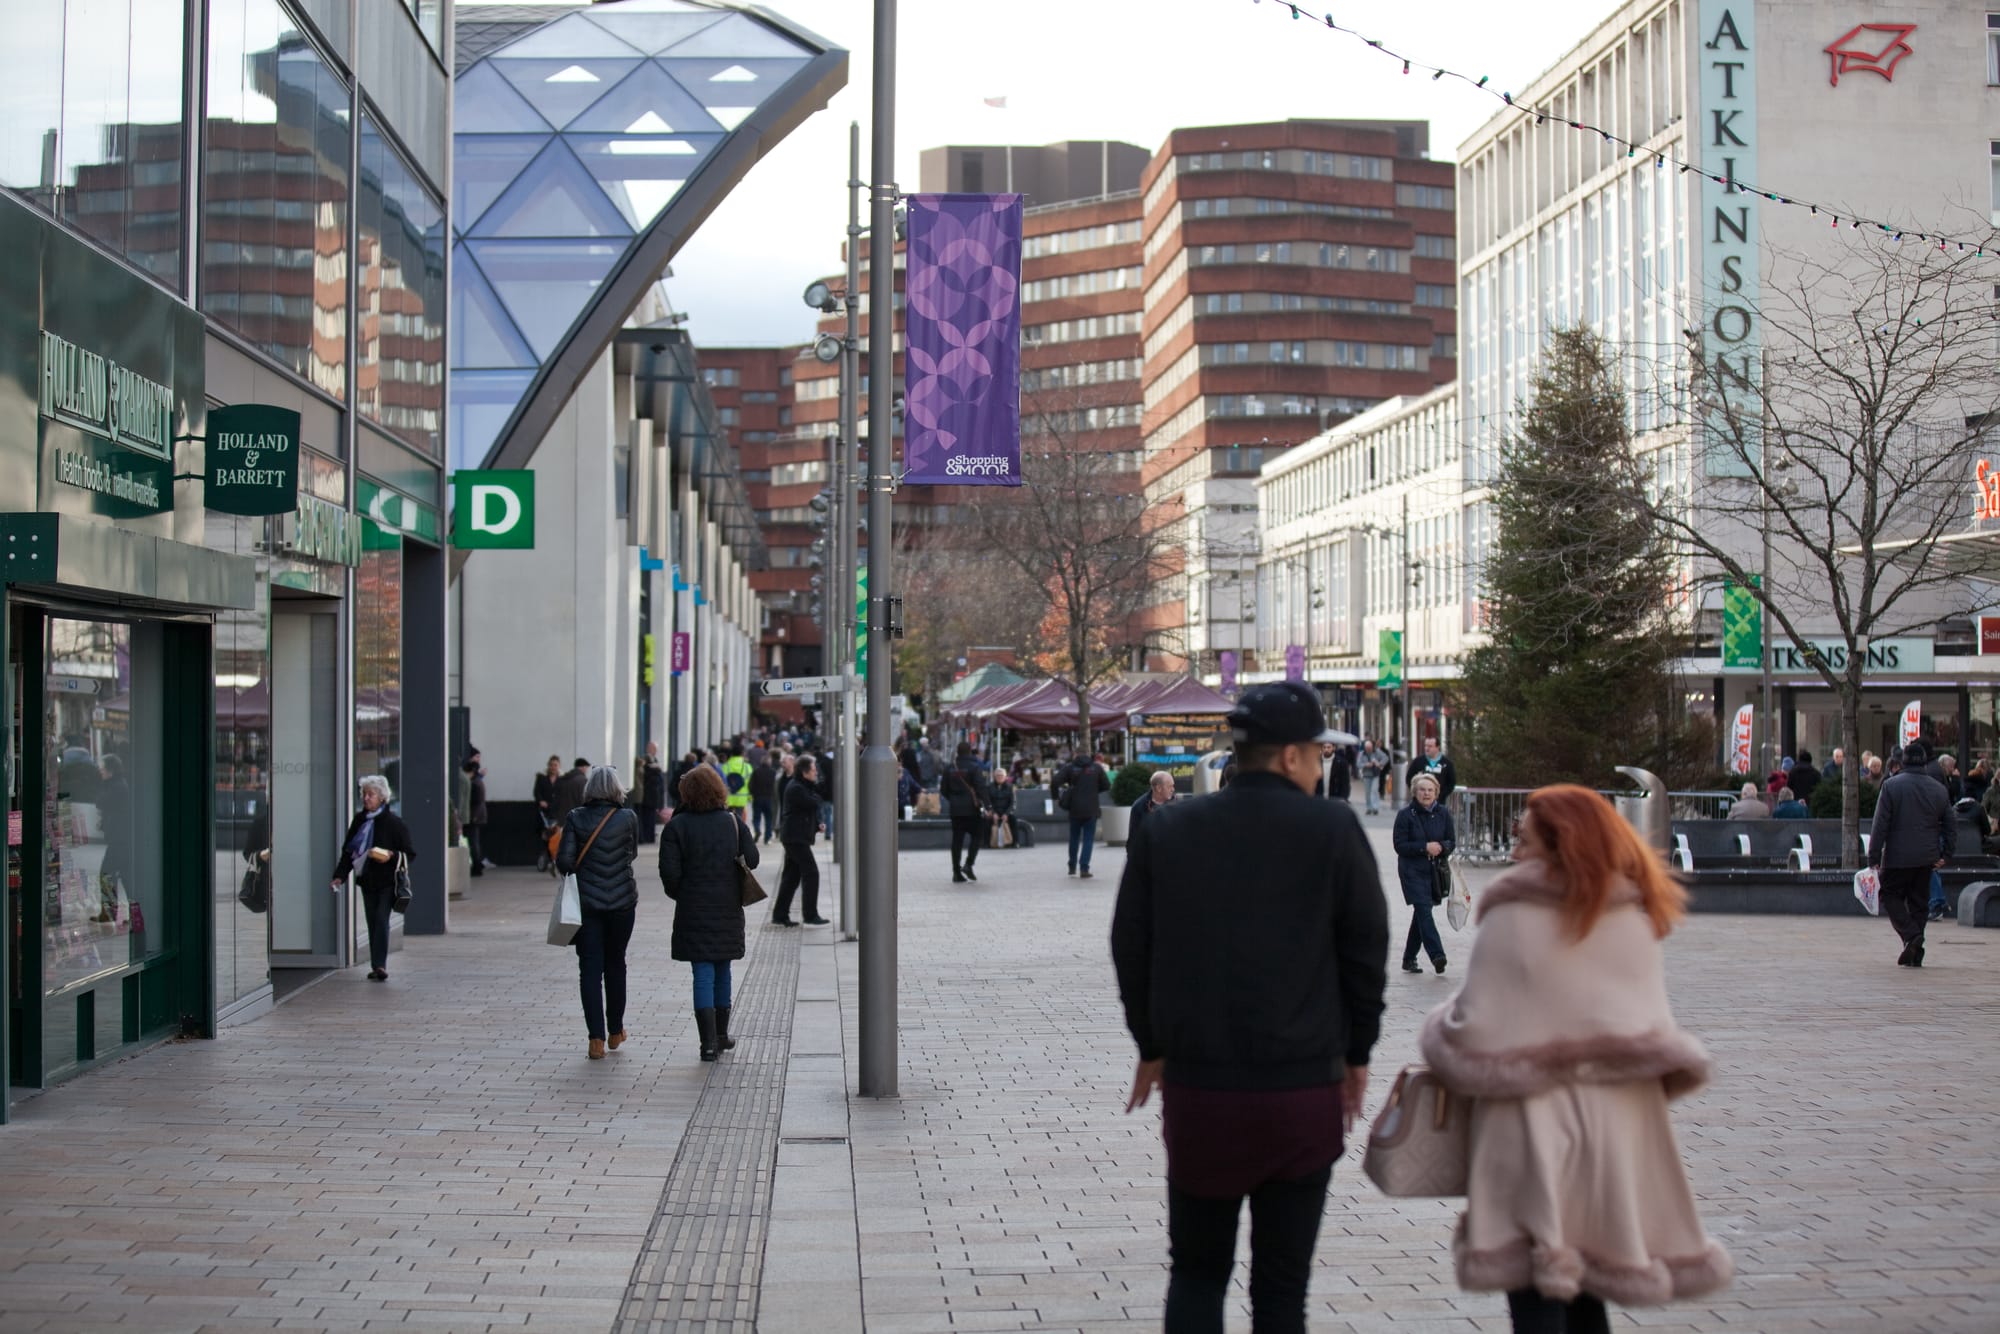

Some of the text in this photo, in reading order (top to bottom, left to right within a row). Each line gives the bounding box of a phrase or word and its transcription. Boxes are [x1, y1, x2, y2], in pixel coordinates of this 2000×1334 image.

[1705, 9, 1752, 441] ATKINSON
[40, 329, 174, 461] HOLLAND & BARRETT
[217, 432, 289, 452] HOLLAND
[245, 450, 259, 468] &
[955, 453, 1009, 468] Shopping
[60, 449, 159, 508] health foods & natural remedies
[216, 468, 286, 488] BARRETT
[472, 485, 521, 535] D
[674, 635, 684, 668] GAME
[1737, 711, 1751, 775] SALE
